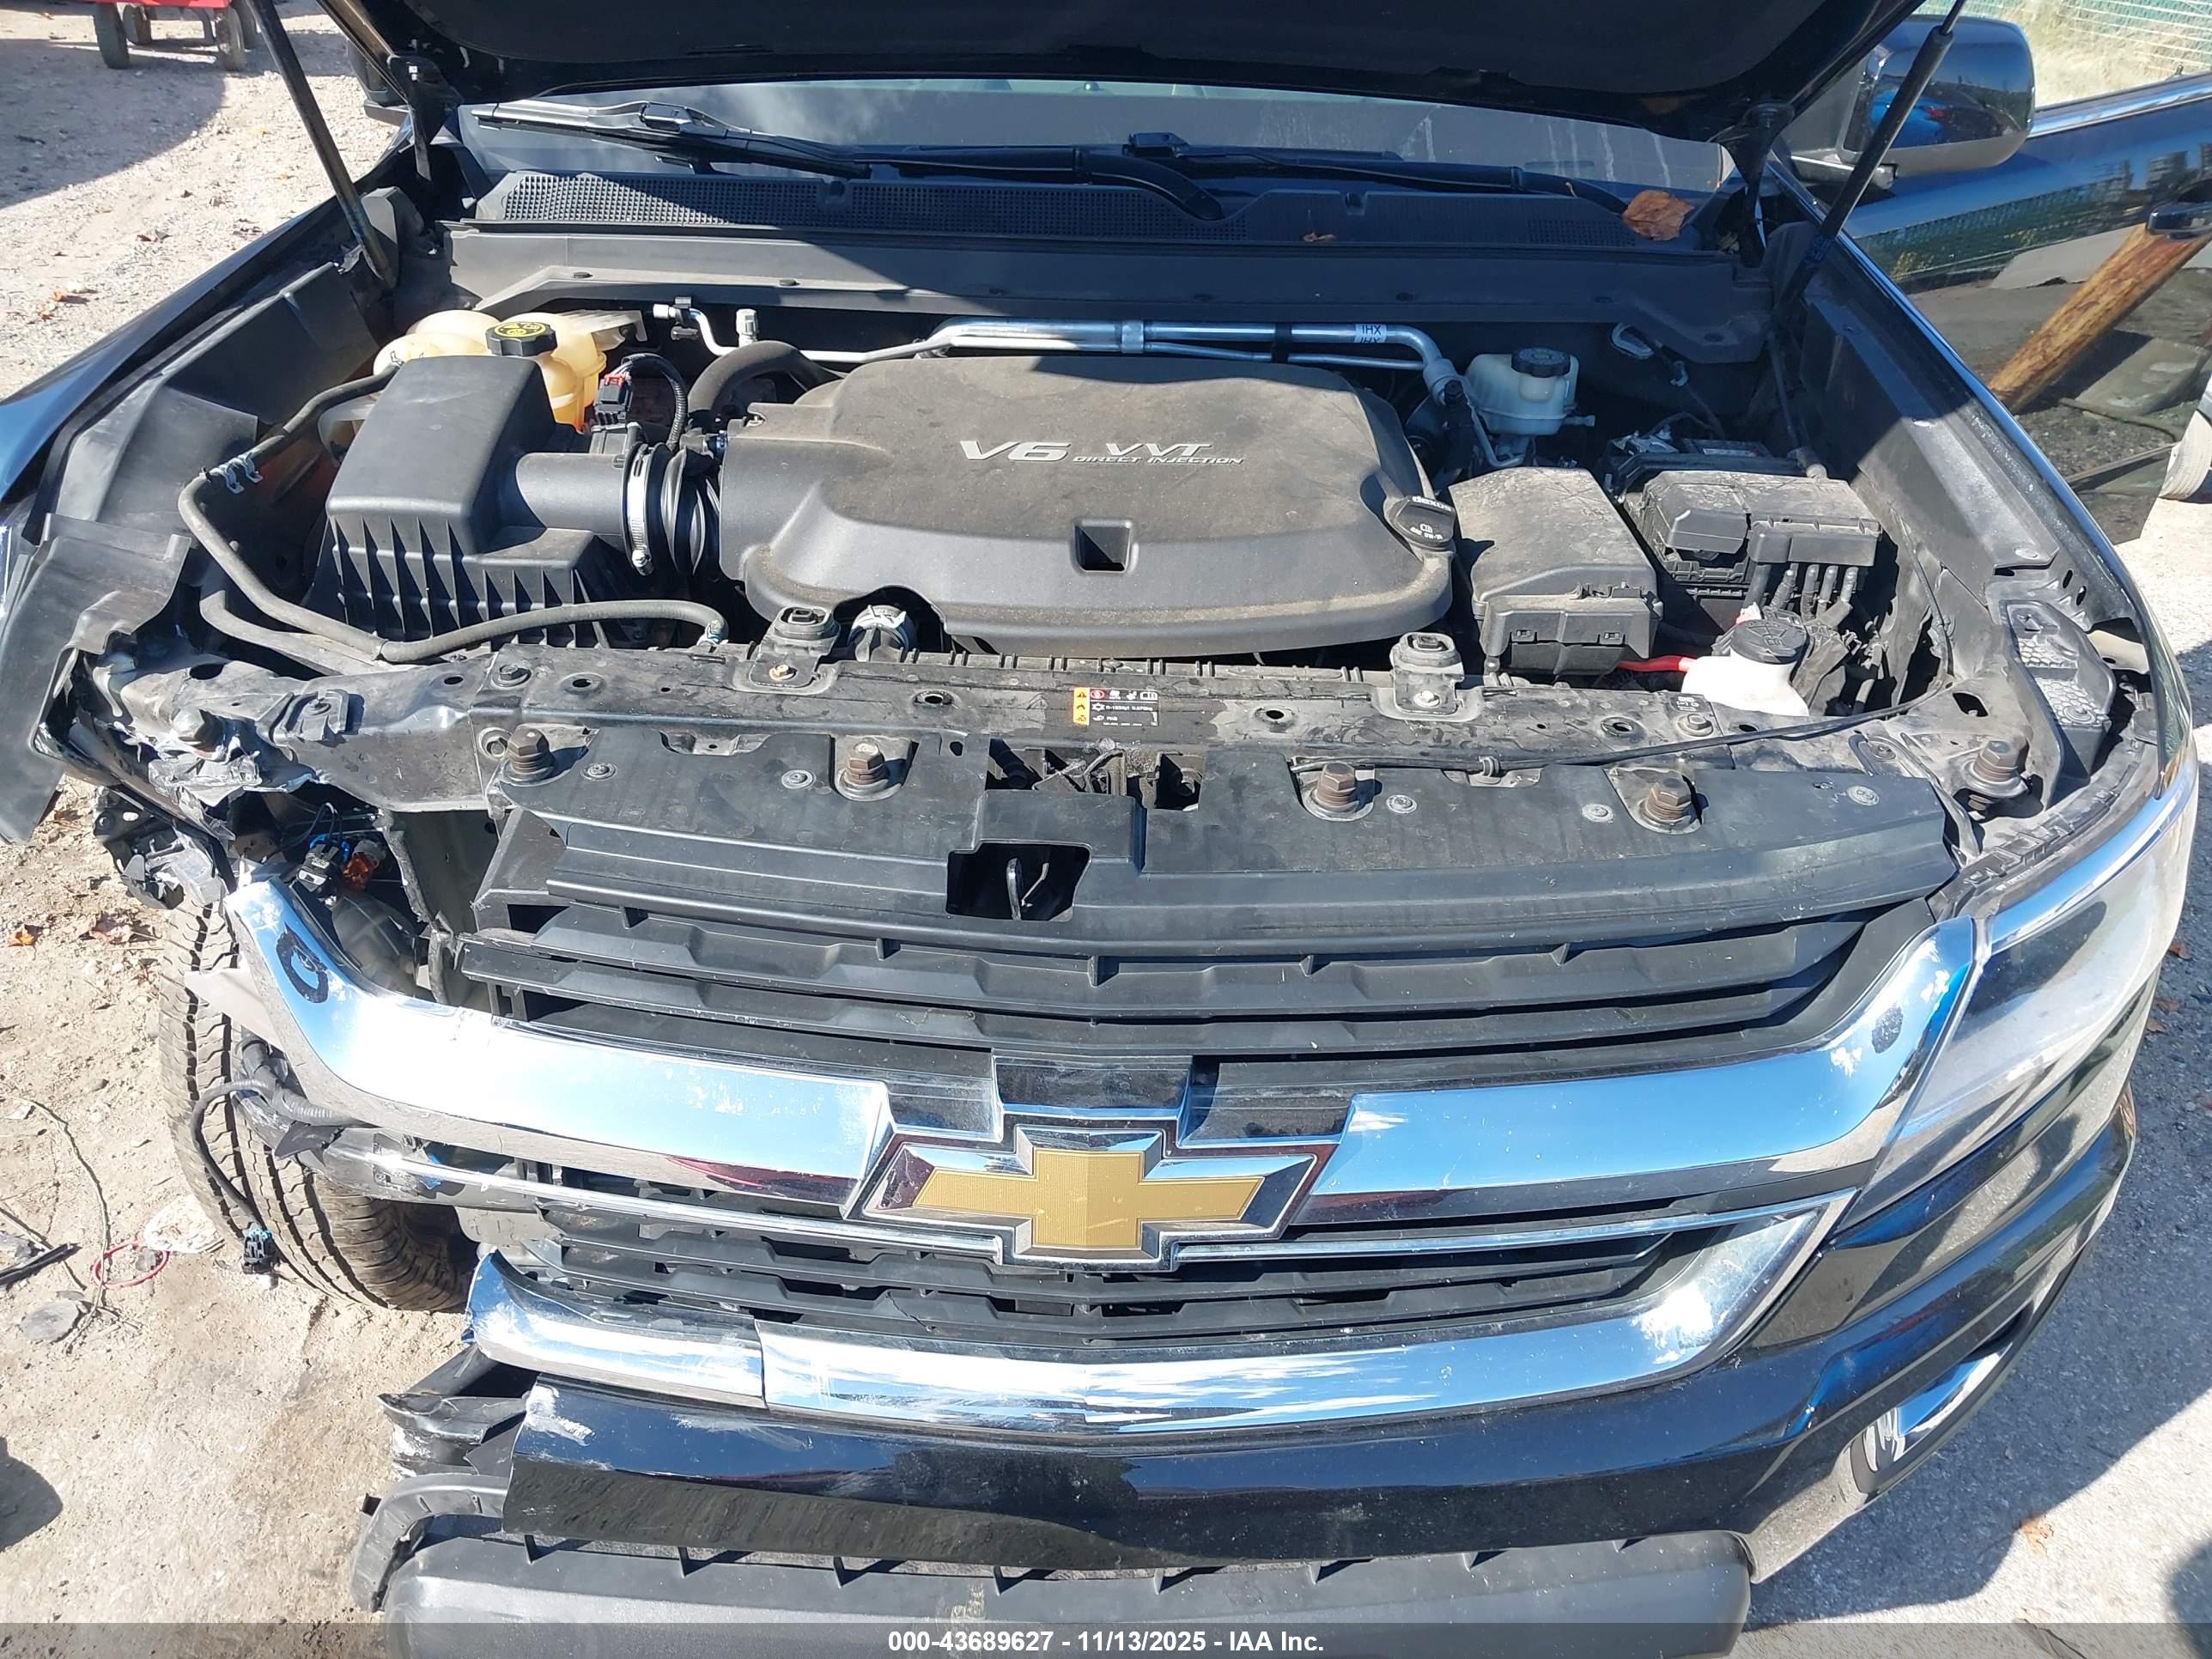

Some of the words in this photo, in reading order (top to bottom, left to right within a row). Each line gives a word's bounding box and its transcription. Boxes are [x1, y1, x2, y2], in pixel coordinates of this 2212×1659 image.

[1362, 325, 1381, 335] IHX
[960, 440, 1071, 462] V6
[1105, 442, 1212, 457] VVT
[1412, 495, 1452, 512] dexos
